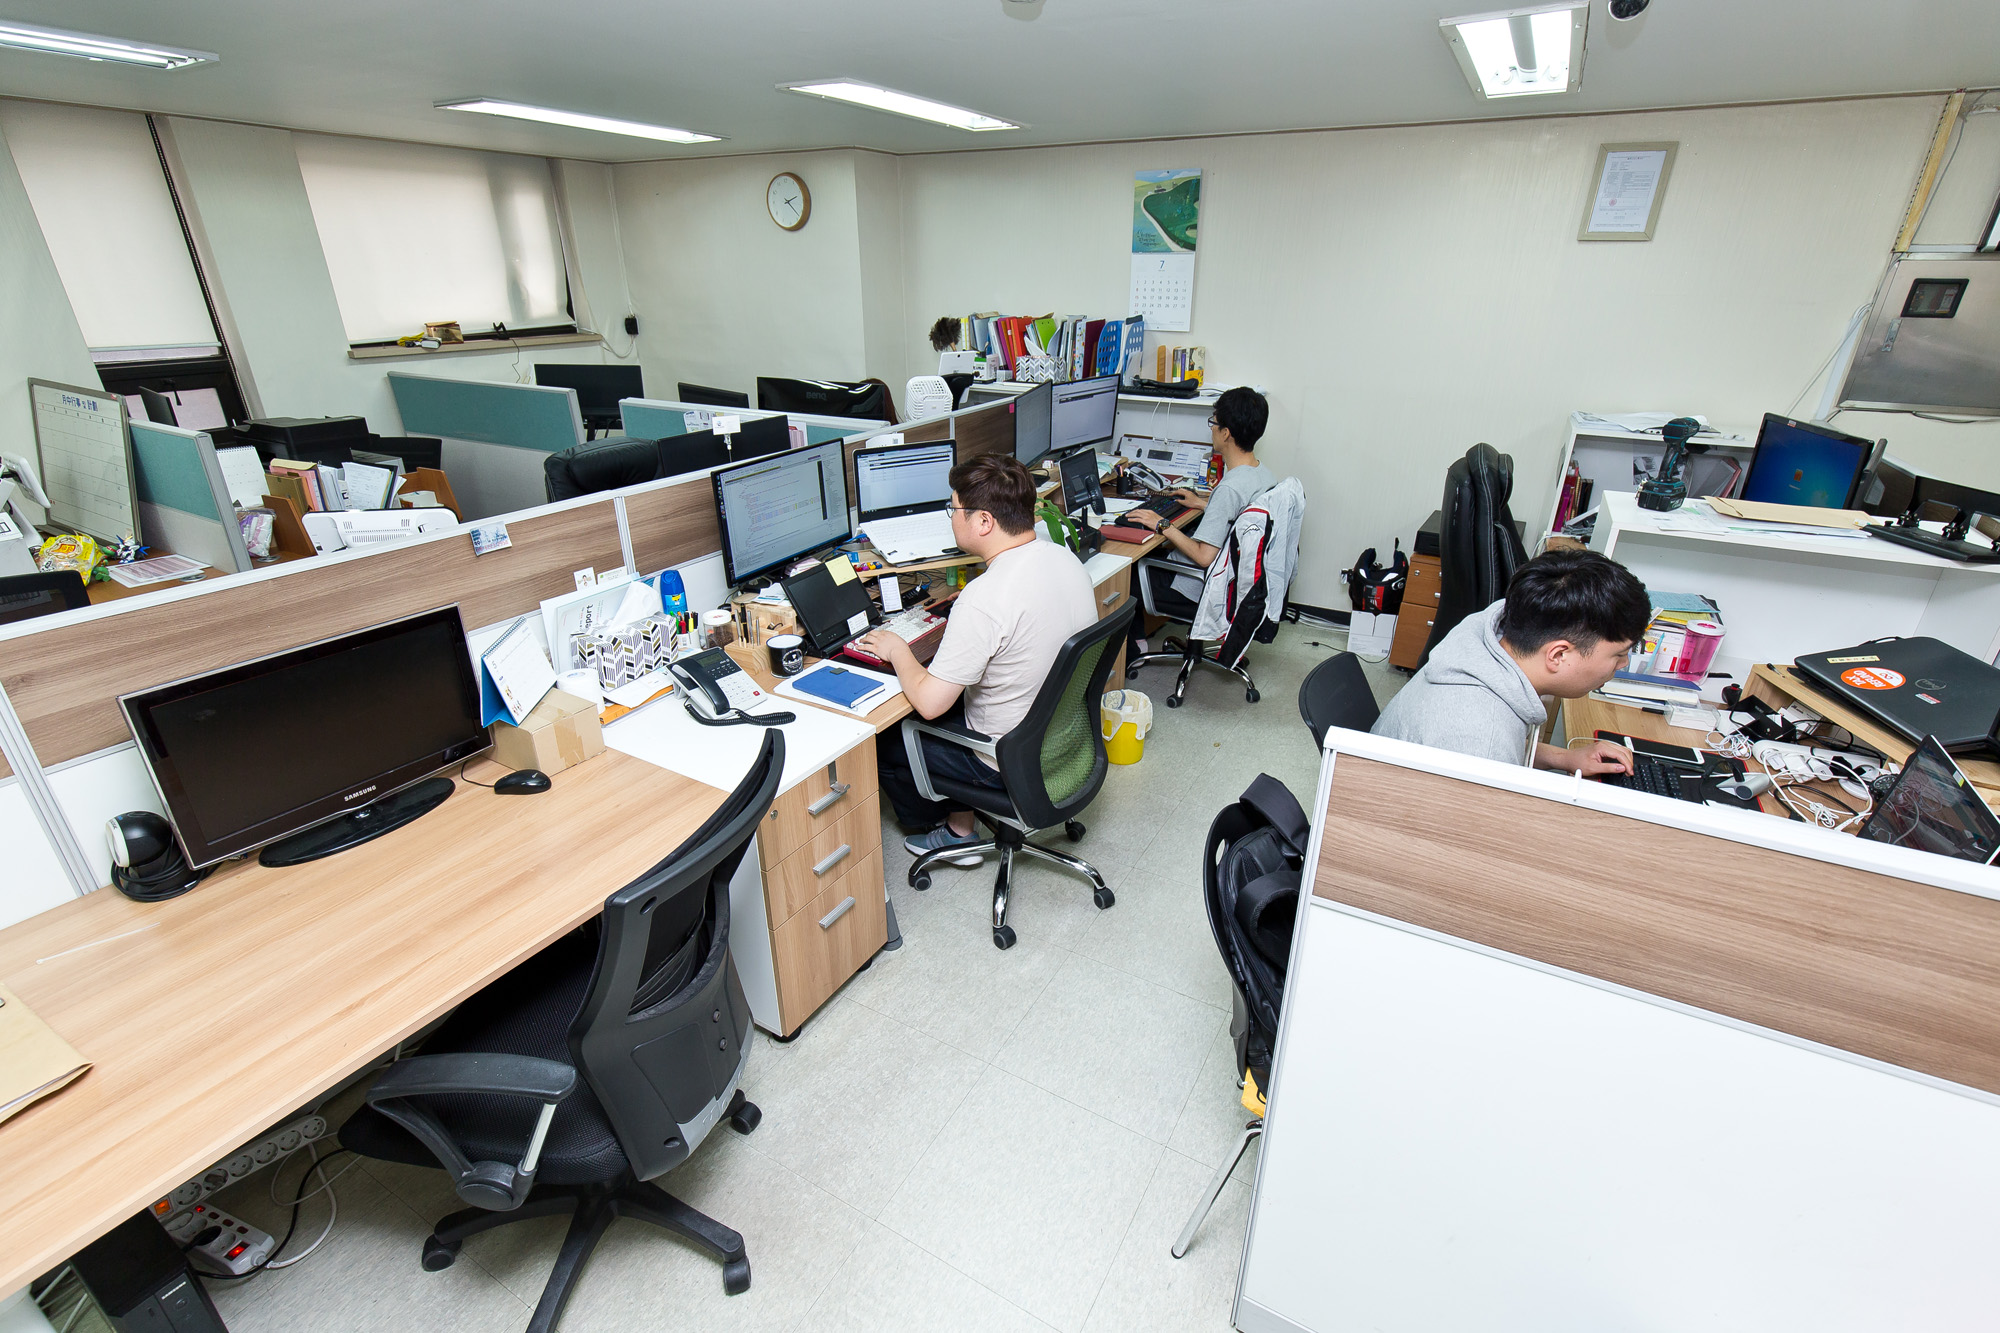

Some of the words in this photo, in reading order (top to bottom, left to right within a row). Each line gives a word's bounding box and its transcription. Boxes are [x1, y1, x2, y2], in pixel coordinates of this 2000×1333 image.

[1160, 260, 1165, 269] 7
[584, 604, 594, 629] eport
[1846, 675, 1867, 686] TAX
[1853, 670, 1887, 688] REFUND
[343, 784, 377, 802] SAMSUNG
